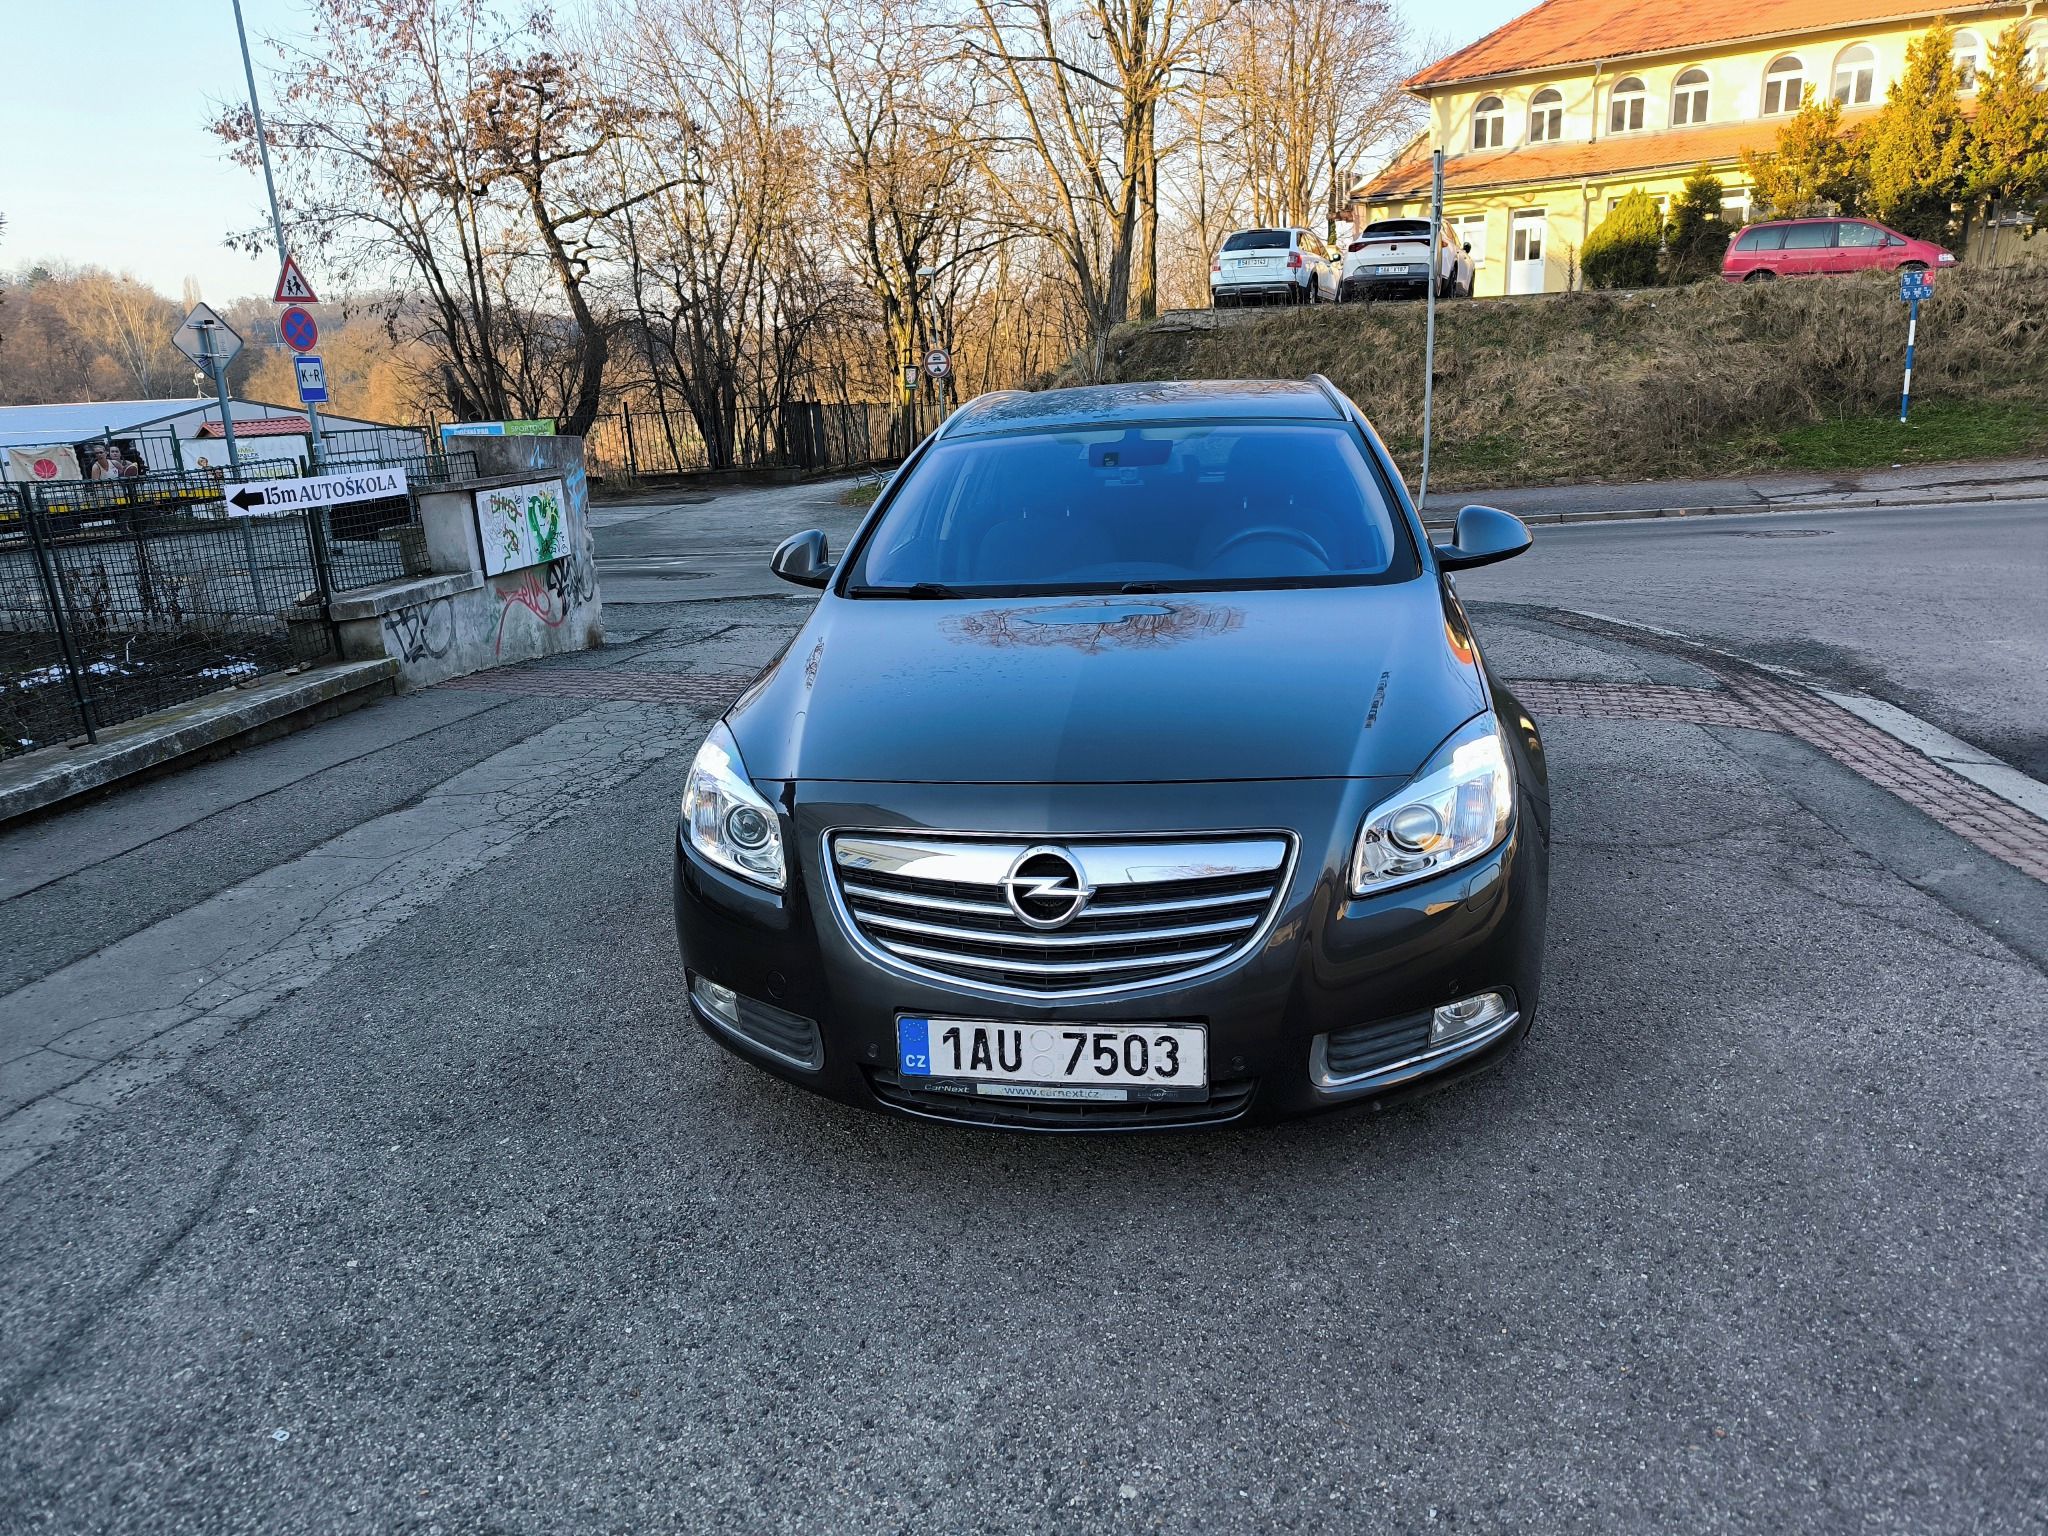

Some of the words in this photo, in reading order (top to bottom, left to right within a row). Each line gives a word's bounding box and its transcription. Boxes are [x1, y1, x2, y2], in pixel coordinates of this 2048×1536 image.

[301, 369, 321, 382] K+R
[264, 486, 298, 505] 15m
[300, 474, 398, 502] AUTOŠKOLA
[943, 1027, 1023, 1073] 1AU
[1062, 1032, 1180, 1078] 7503
[905, 1055, 927, 1068] CZ
[924, 1083, 970, 1094] CarNext
[1004, 1087, 1100, 1099] www.carnext.cz
